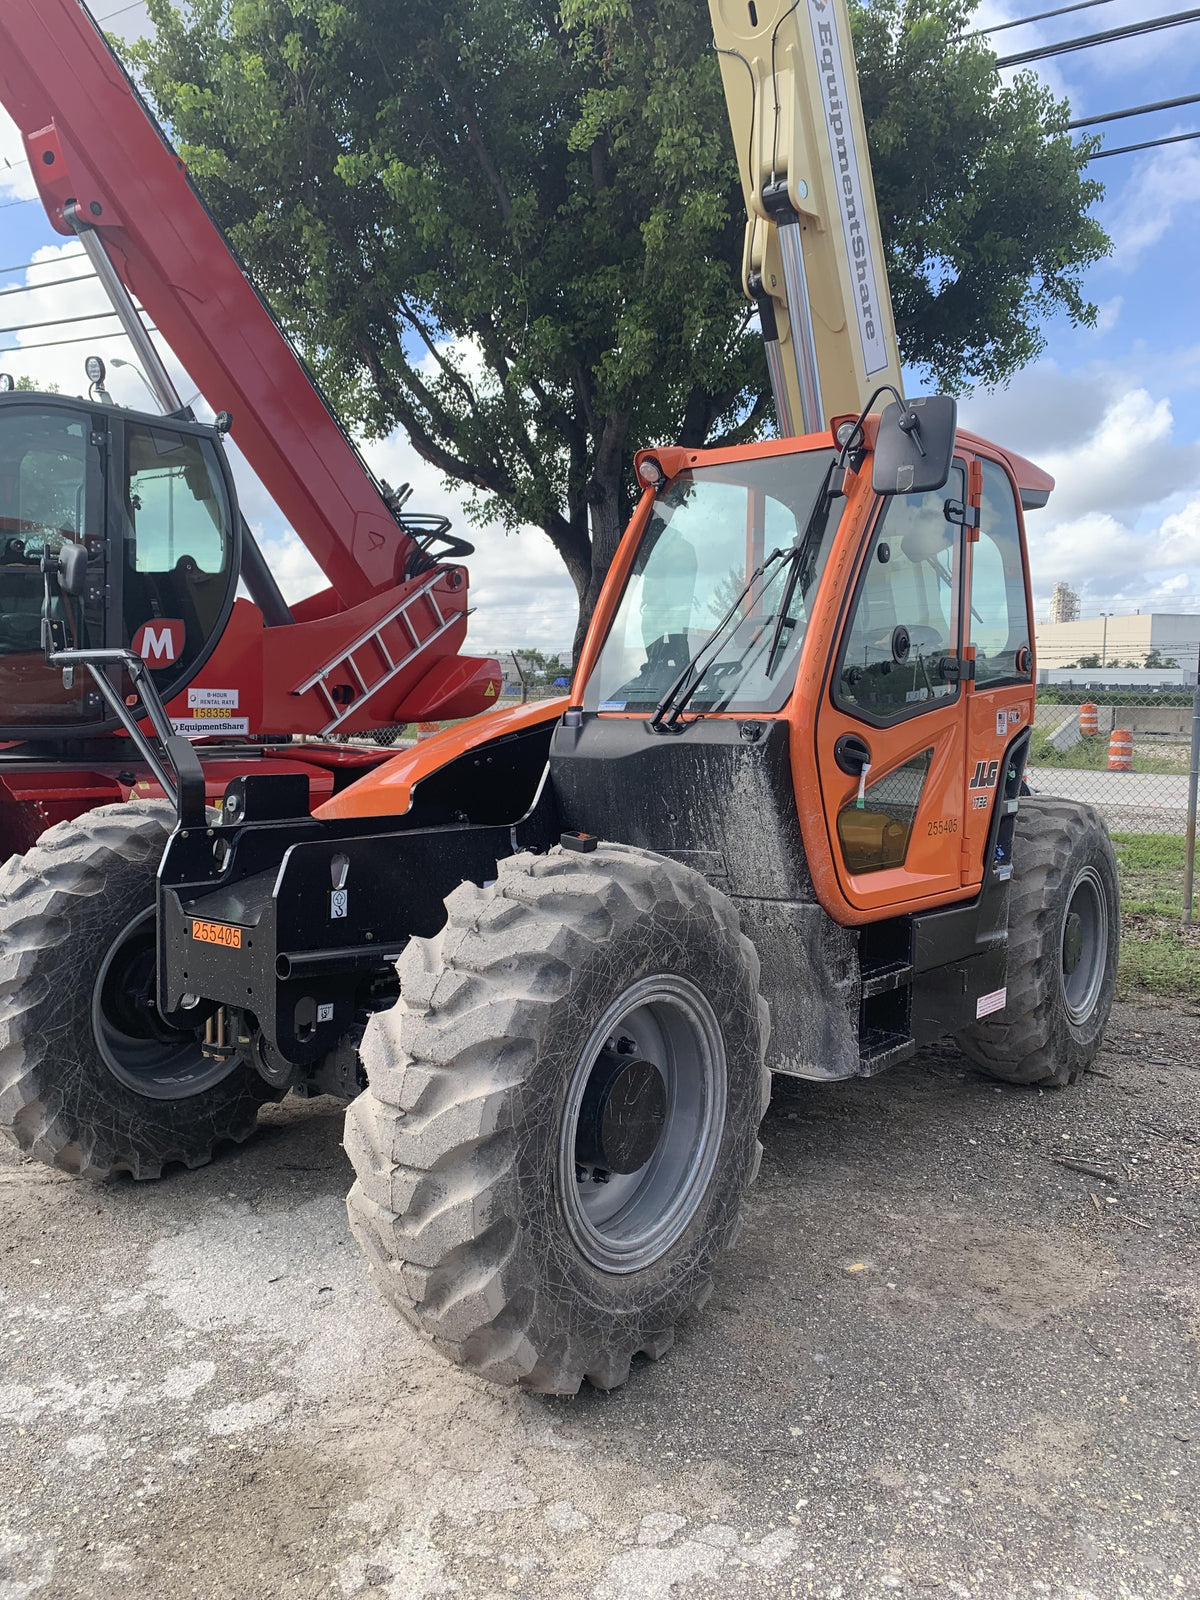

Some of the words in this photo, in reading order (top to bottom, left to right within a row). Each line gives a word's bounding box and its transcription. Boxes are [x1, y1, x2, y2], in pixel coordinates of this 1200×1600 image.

[817, 21, 875, 341] EquipmentShare
[140, 627, 174, 659] M
[194, 708, 231, 718] 158355
[179, 722, 245, 732] EquipmentShare
[969, 760, 1000, 789] JLG
[927, 818, 958, 836] 255405
[193, 921, 240, 947] 255405
